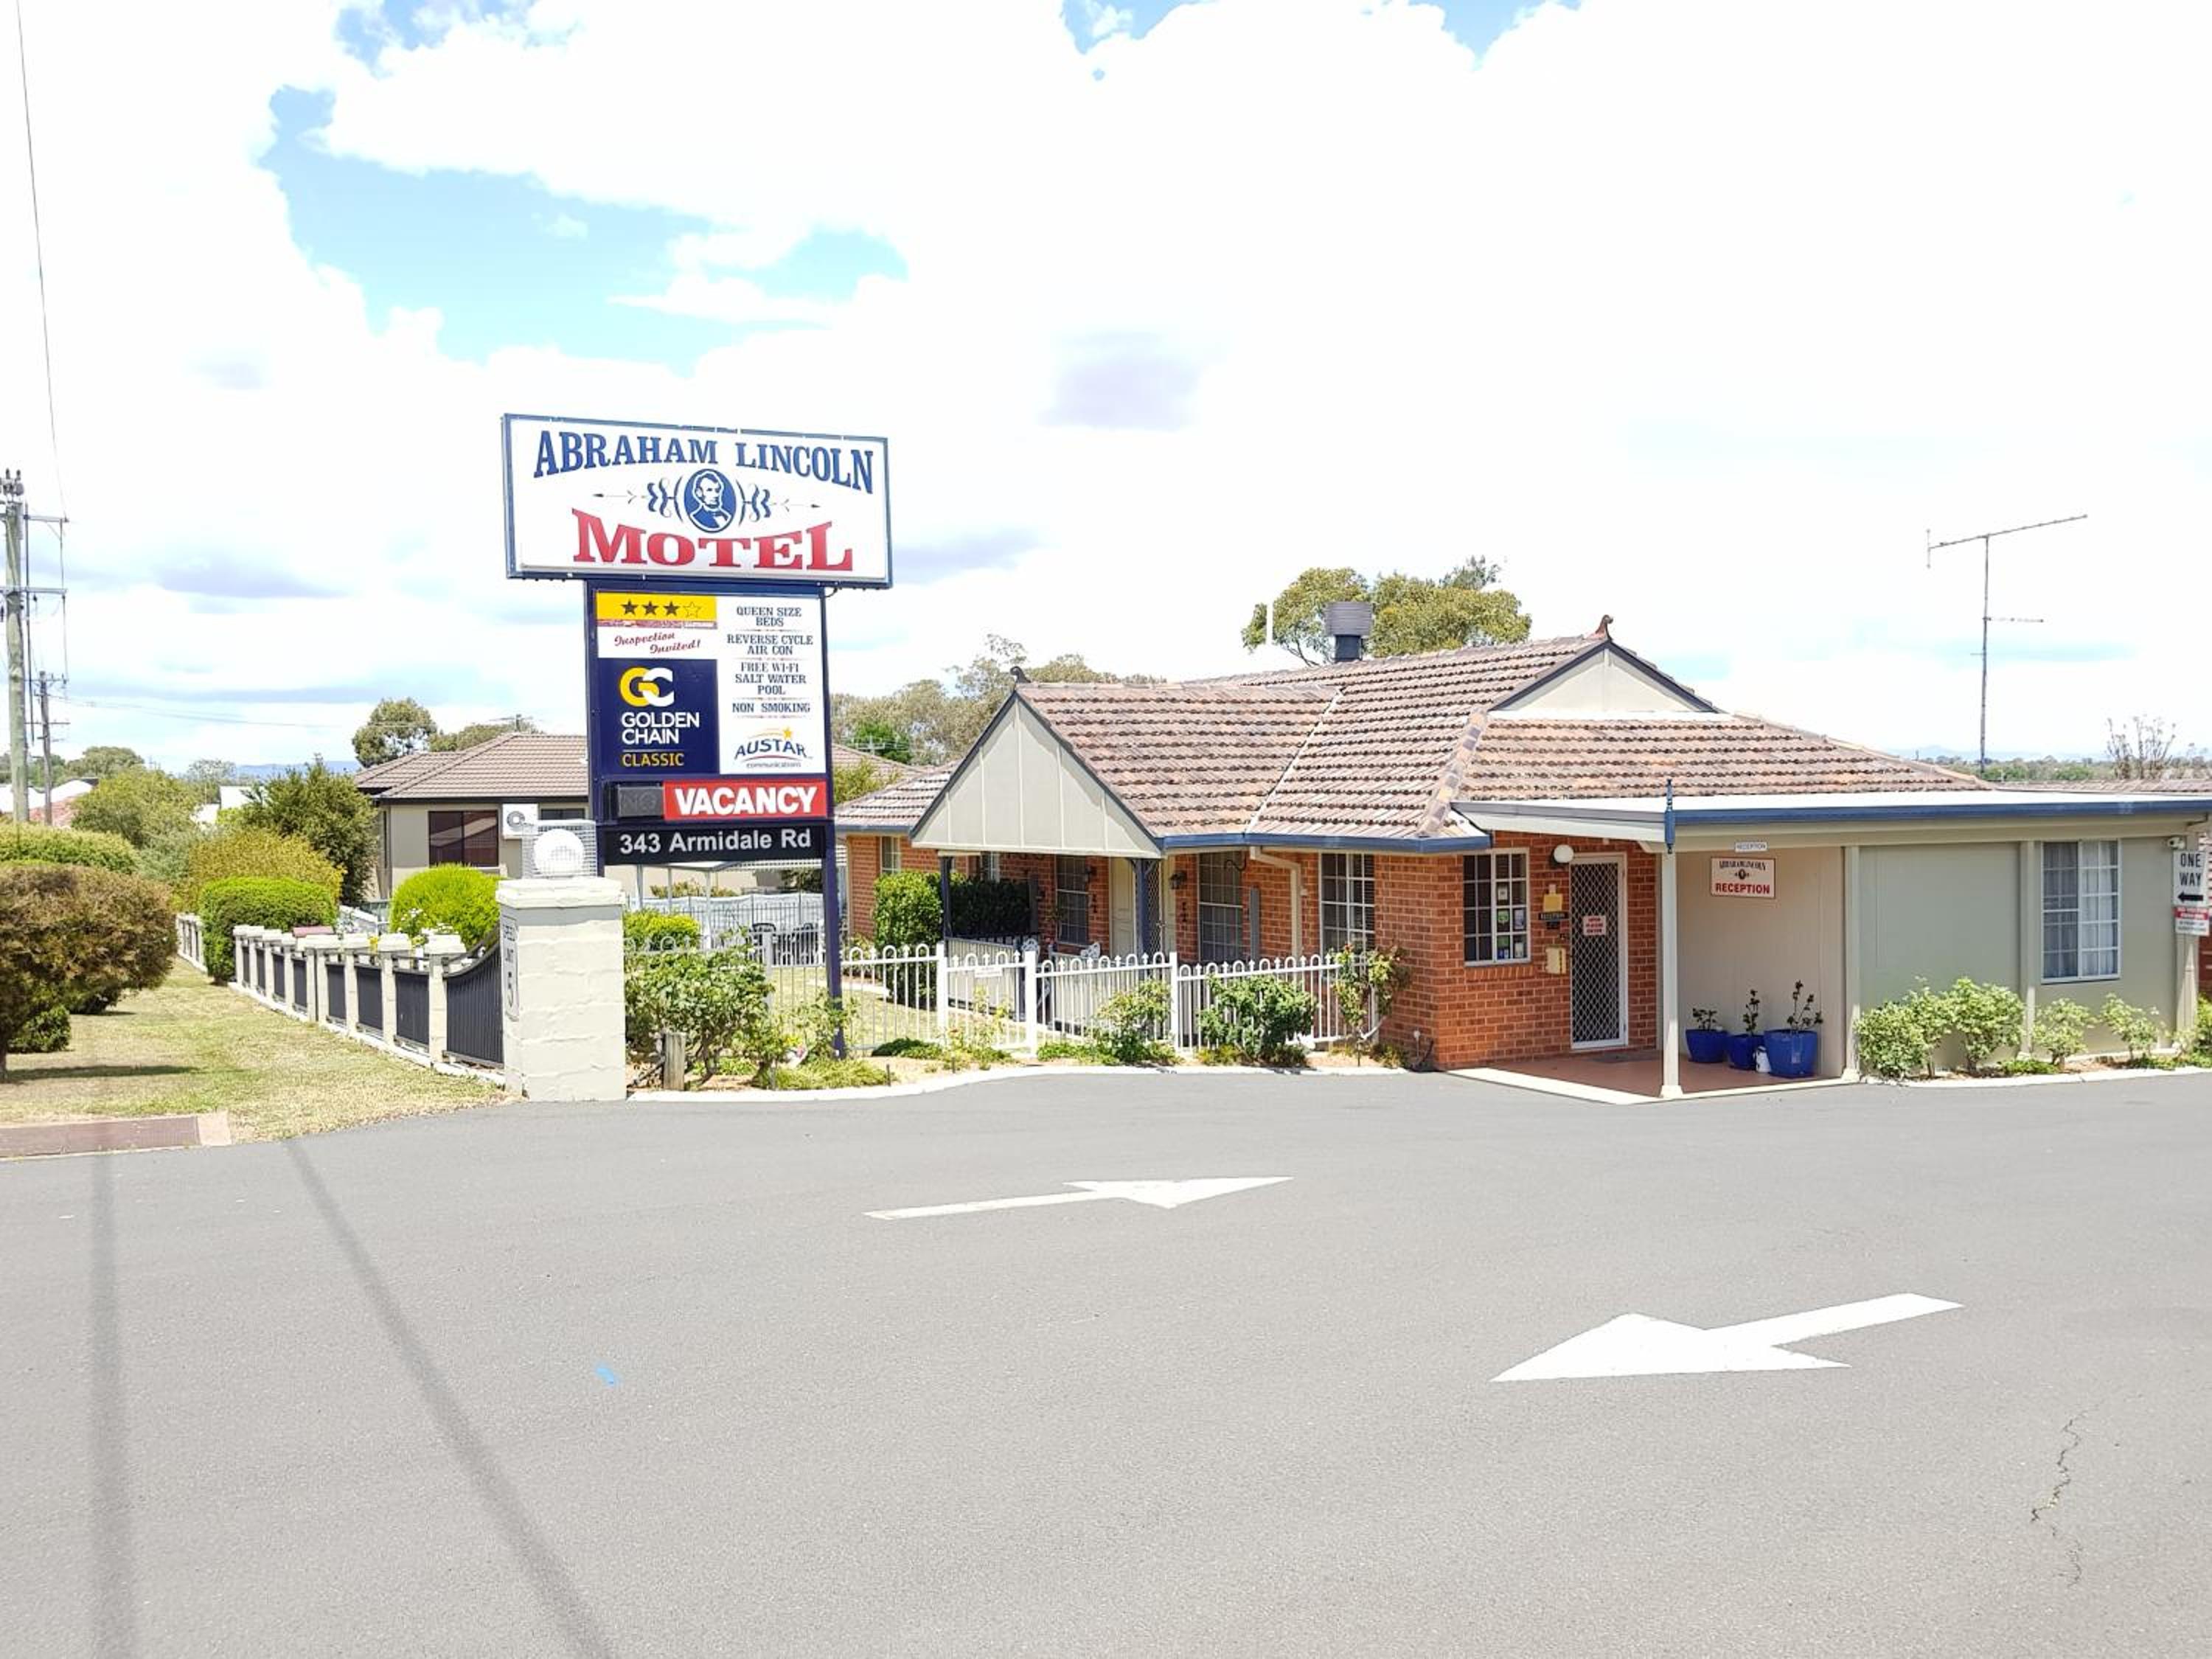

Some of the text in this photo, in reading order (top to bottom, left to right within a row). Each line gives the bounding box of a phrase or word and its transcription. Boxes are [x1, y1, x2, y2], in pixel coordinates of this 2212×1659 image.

[533, 429, 873, 495] ABRAHAM LINCOLN
[571, 507, 853, 571] MOTEL
[737, 606, 801, 616] QUEEN SIZE
[756, 616, 784, 627] BEDS
[614, 632, 675, 647] Inspection
[727, 633, 813, 645] REVERSE CYCLE
[747, 645, 793, 655] AIR CON
[741, 661, 768, 672] FREE
[735, 673, 807, 684] SALT WATER
[757, 685, 786, 695] POOL
[732, 703, 810, 713] NON SMOKING
[622, 712, 700, 728] GOLDEN
[622, 728, 680, 745] CHAIN
[734, 738, 807, 760] AUSTAR
[622, 753, 685, 767] CLASSIC
[674, 786, 818, 816] VACANCY
[619, 828, 812, 855] 343 Armidale Rd
[2180, 853, 2202, 868] ONE
[2180, 872, 2202, 886] WAY
[1715, 883, 1770, 894] RECEPTION
